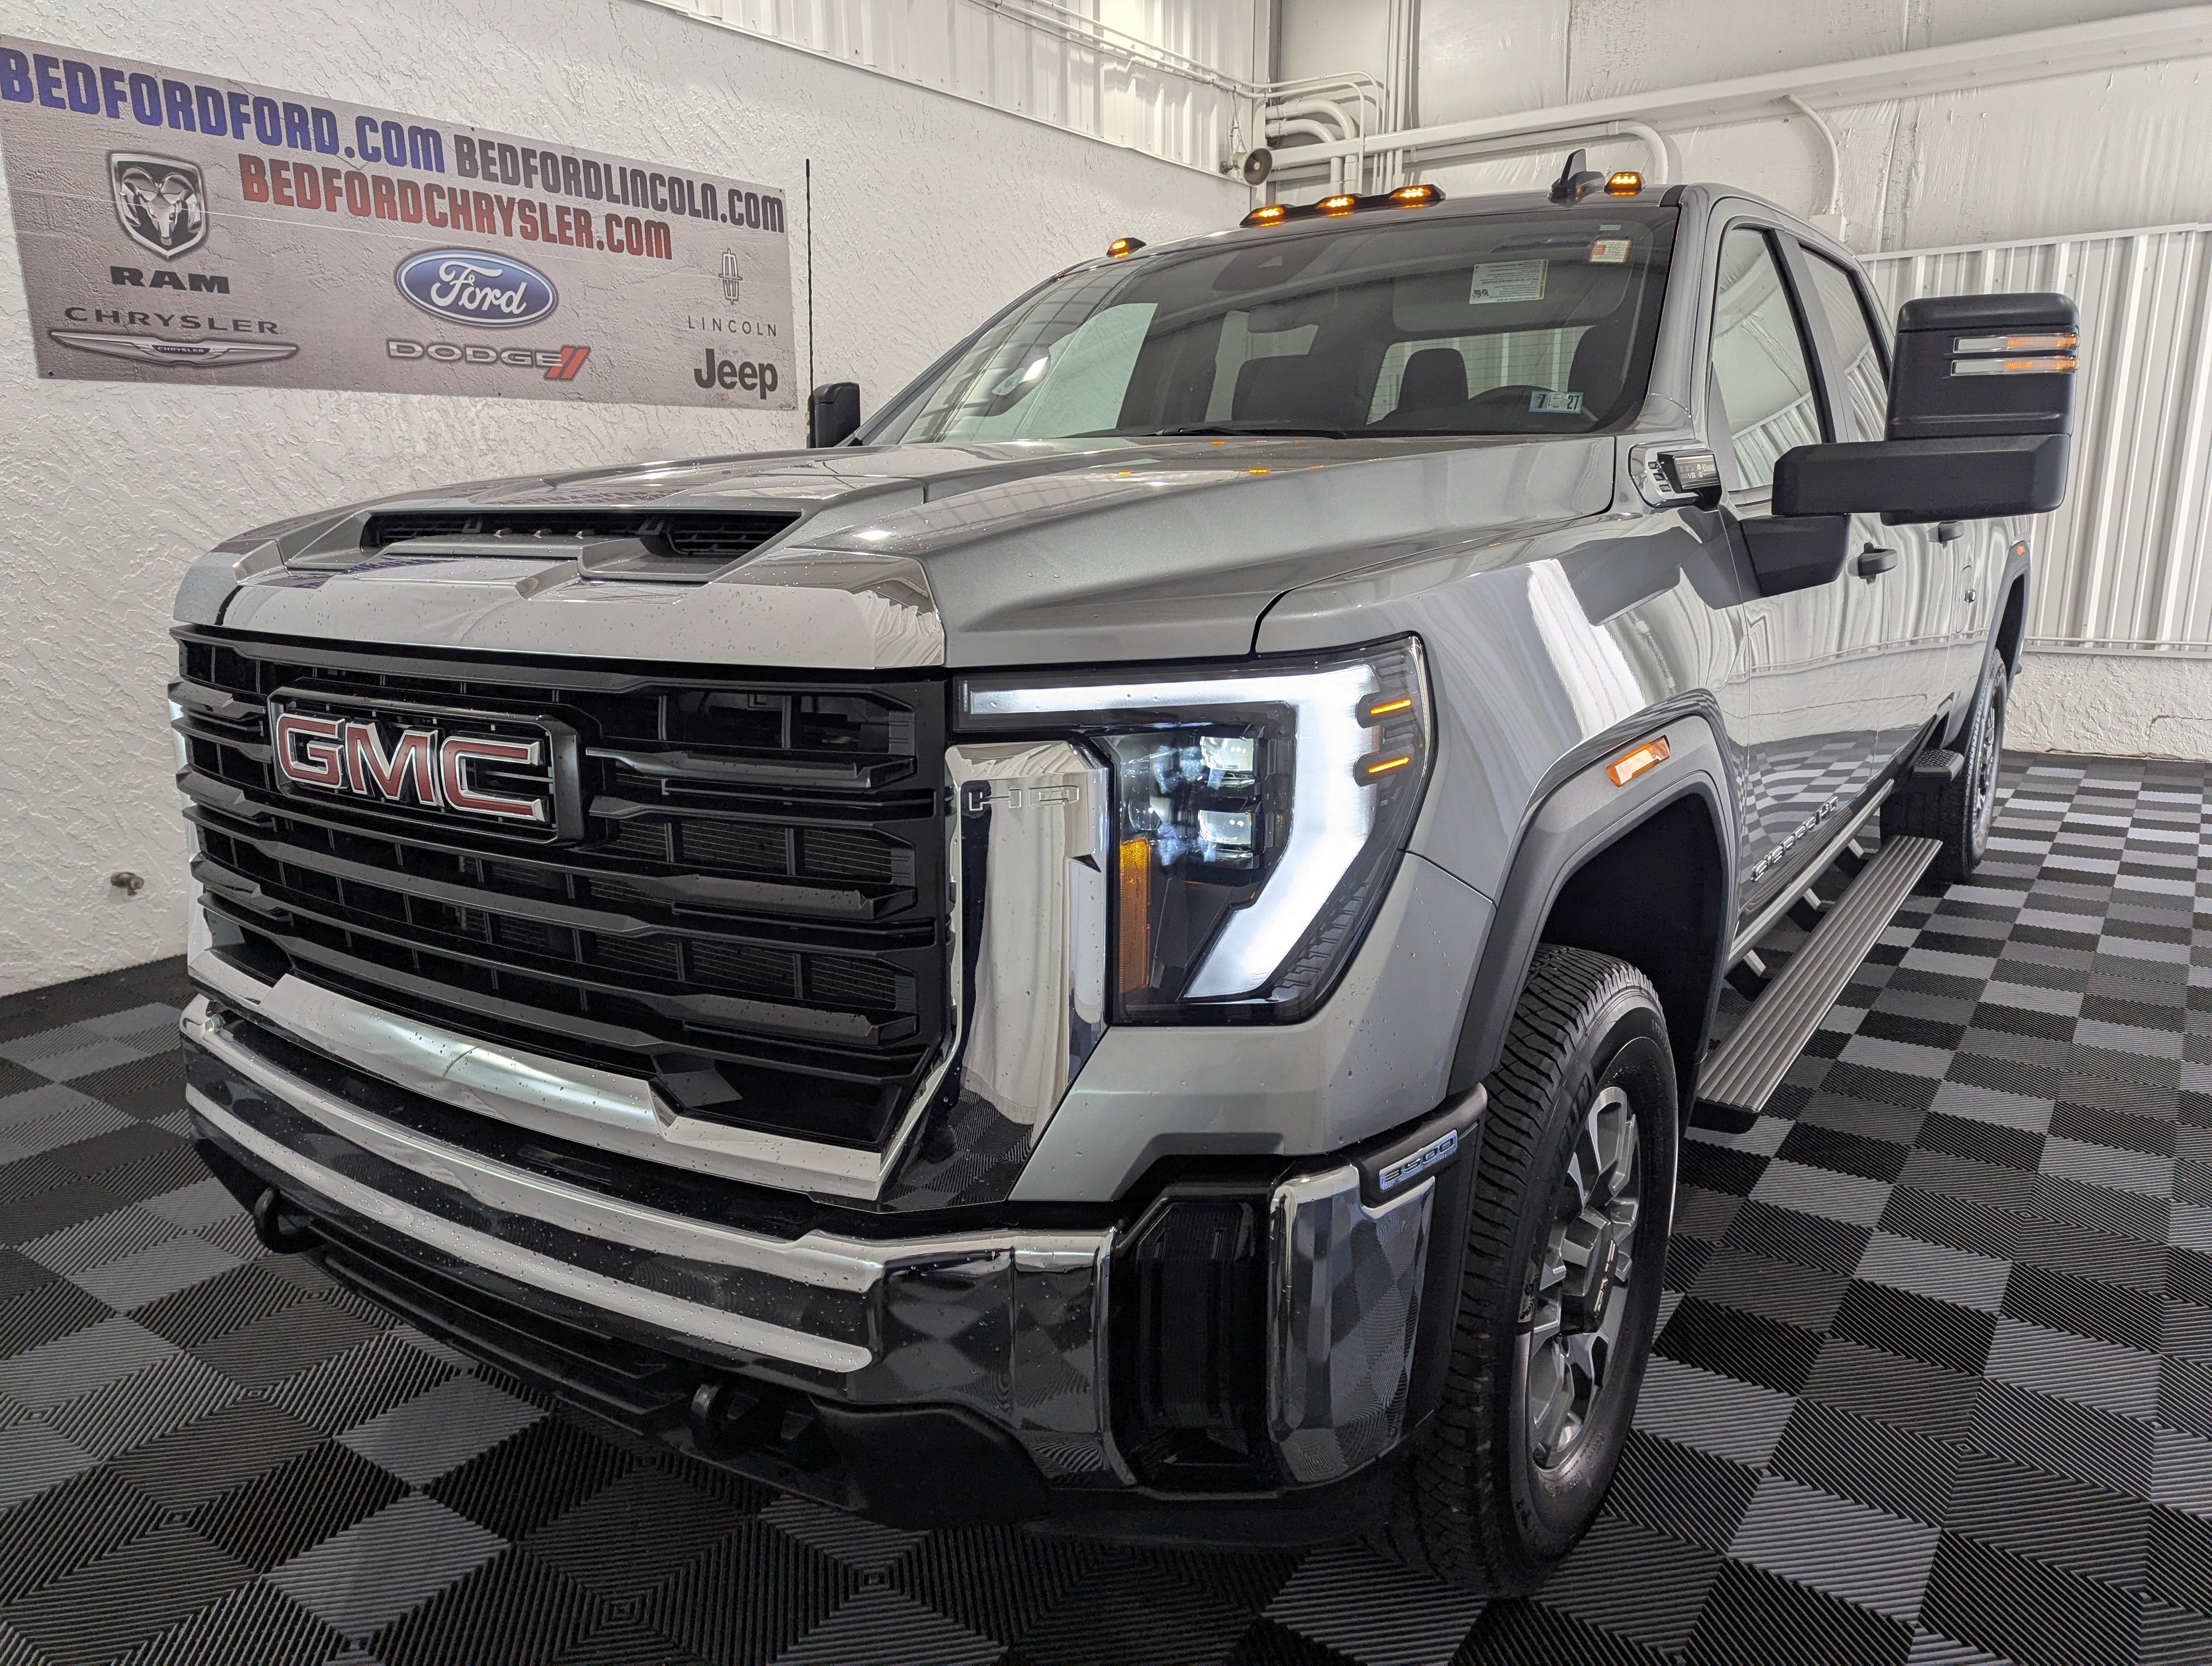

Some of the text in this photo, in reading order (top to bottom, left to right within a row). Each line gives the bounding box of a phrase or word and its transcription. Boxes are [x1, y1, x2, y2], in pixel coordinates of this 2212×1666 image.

[0, 47, 785, 233] BEDFORDFORD.COM BEDFORDLINCOLN.COM
[238, 153, 672, 260] BEDFORDCHRYSLER.COM
[110, 266, 230, 294] RAM
[430, 260, 528, 316] Ford
[63, 306, 279, 335] CHRYSLER
[687, 316, 777, 337] LINCOLN
[387, 340, 563, 369] DODGE
[693, 348, 779, 400] Jeep
[1538, 394, 1547, 408] 7
[1567, 395, 1580, 411] 27
[276, 712, 545, 823] GMC
[1384, 1137, 1454, 1183] 3500
